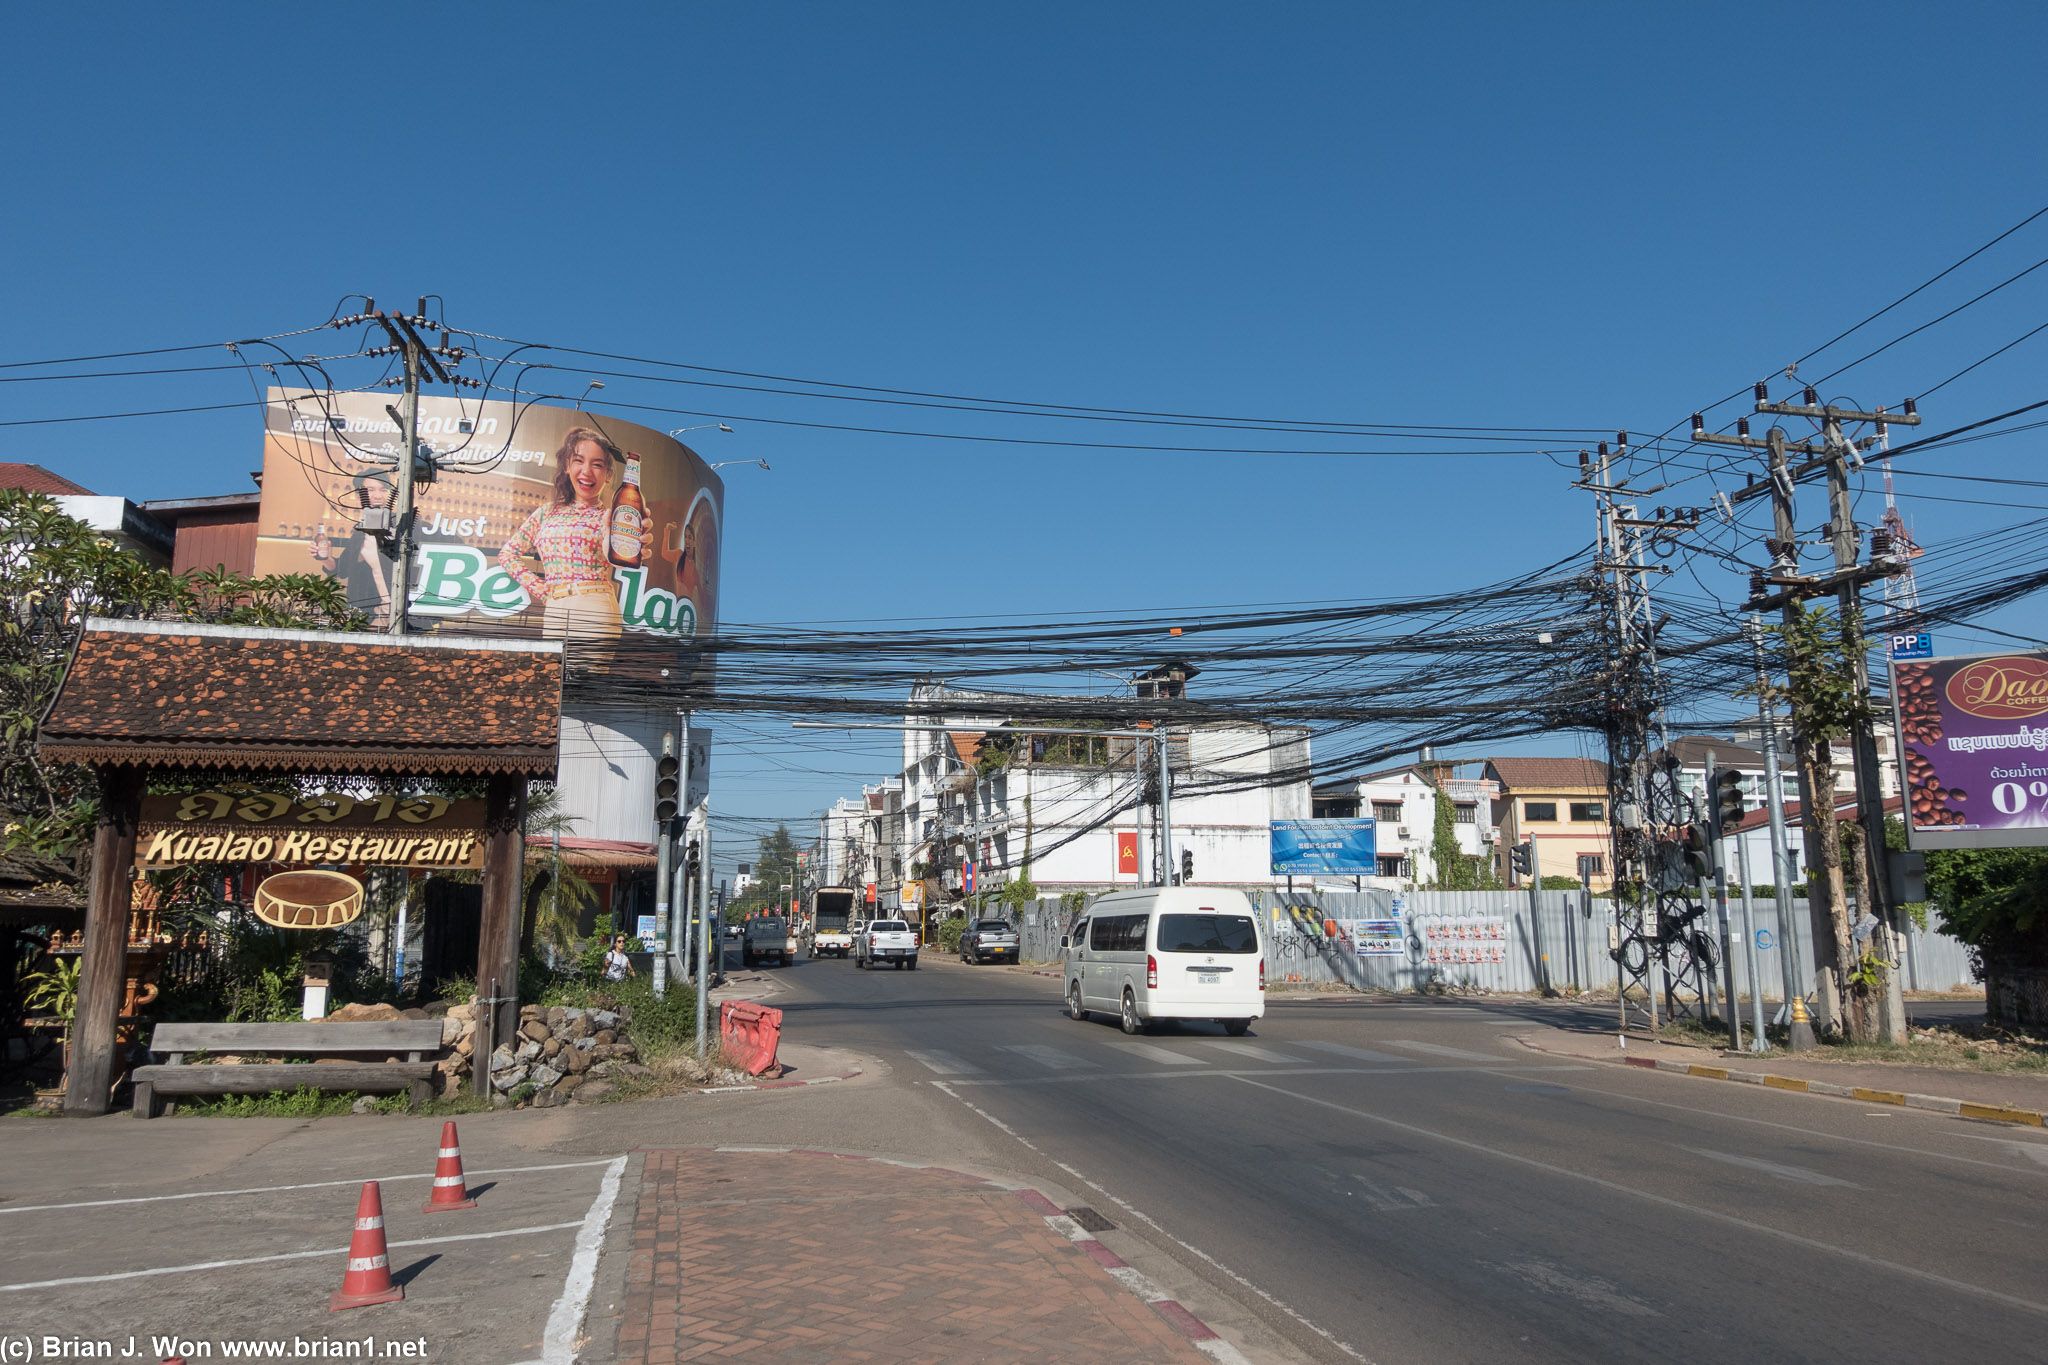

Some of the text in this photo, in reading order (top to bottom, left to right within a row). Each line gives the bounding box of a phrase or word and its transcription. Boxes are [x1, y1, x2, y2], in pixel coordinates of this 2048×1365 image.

[422, 512, 487, 537] Just
[1893, 635, 1930, 650] PPB
[2006, 696, 2048, 706] COFFE
[144, 829, 475, 862] Kualao Restaurant
